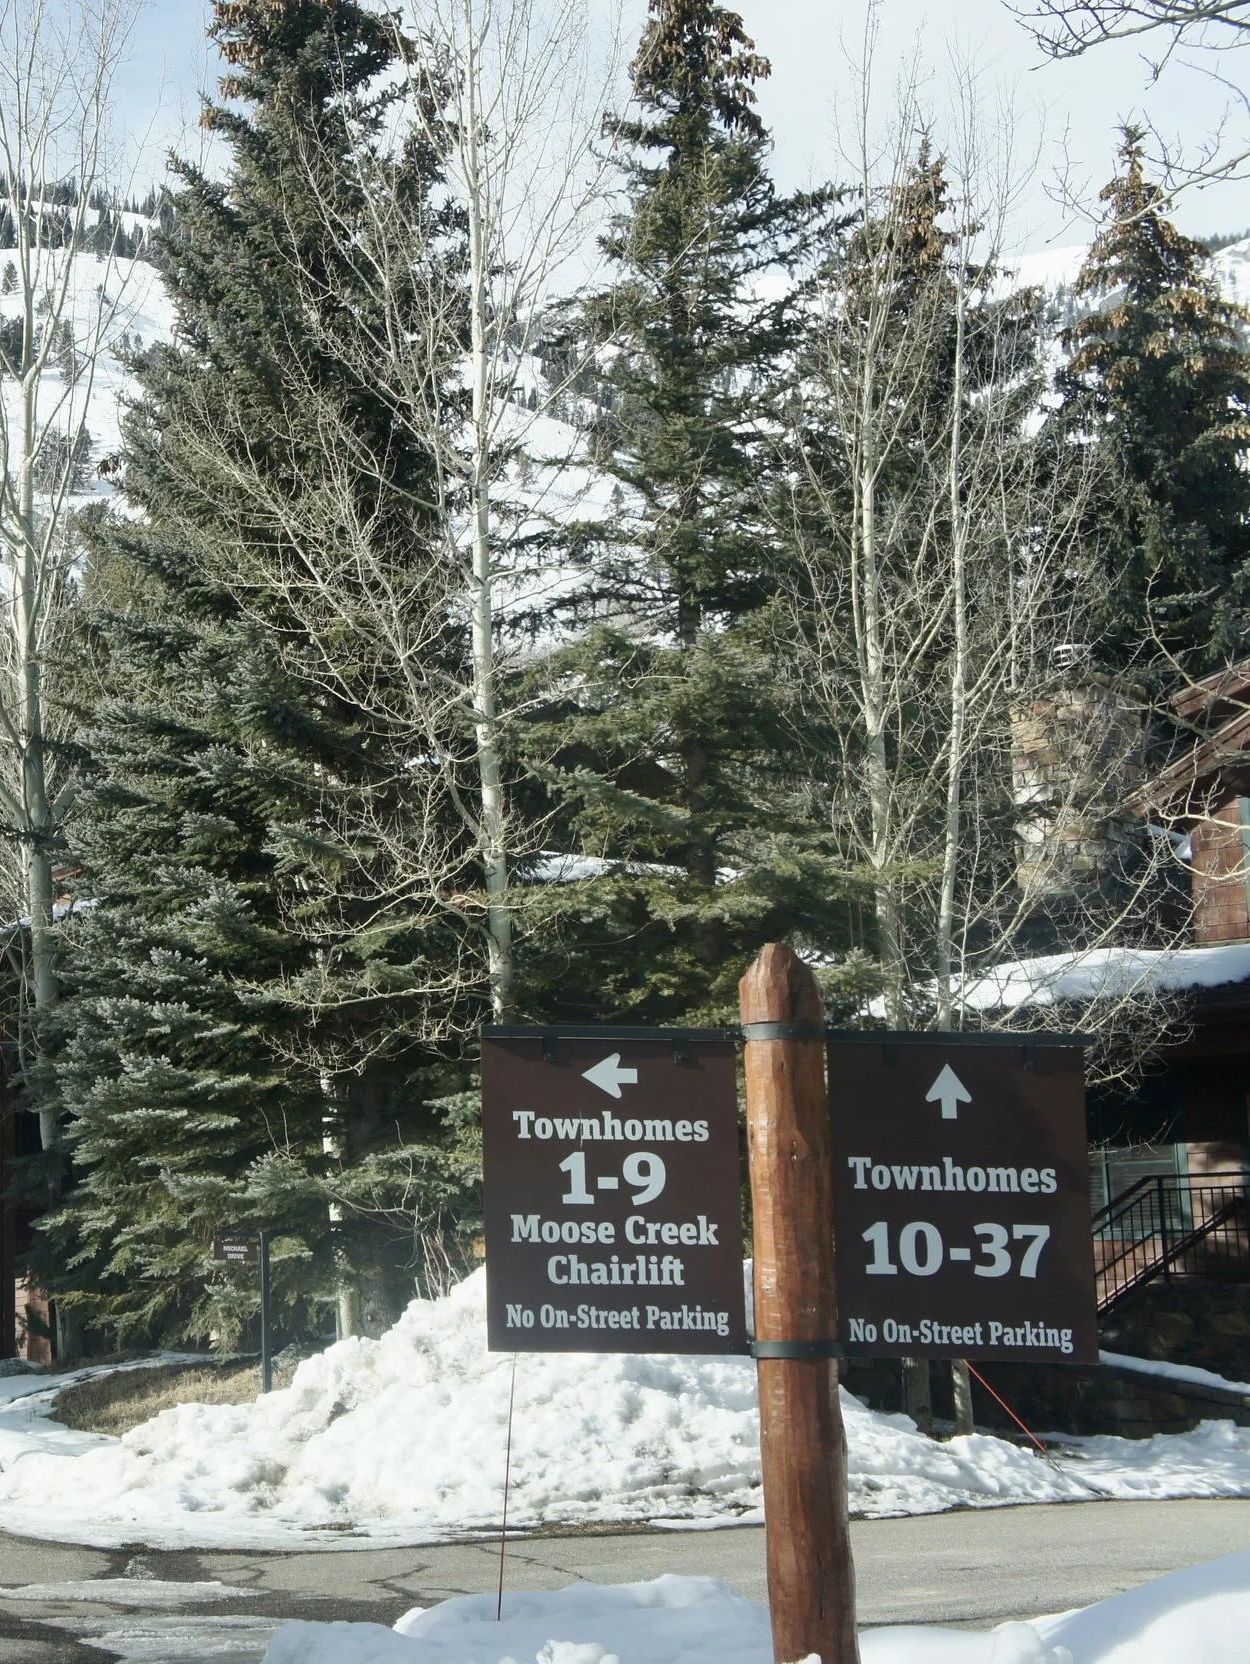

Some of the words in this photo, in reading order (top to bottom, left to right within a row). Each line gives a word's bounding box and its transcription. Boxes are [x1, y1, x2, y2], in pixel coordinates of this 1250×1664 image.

[512, 1110, 710, 1142] Townhomes
[558, 1151, 667, 1206] 1-9
[847, 1156, 1058, 1194] Townhomes
[510, 1214, 616, 1245] Moose
[624, 1215, 720, 1246] Creek
[861, 1221, 1052, 1279] 10-37
[547, 1254, 686, 1286] Chairlift
[505, 1303, 535, 1329] No
[539, 1303, 641, 1330] On-Street
[645, 1305, 730, 1337] Parking
[848, 1318, 878, 1343] No
[882, 1318, 984, 1346] On-Street
[988, 1321, 1074, 1354] Parking
